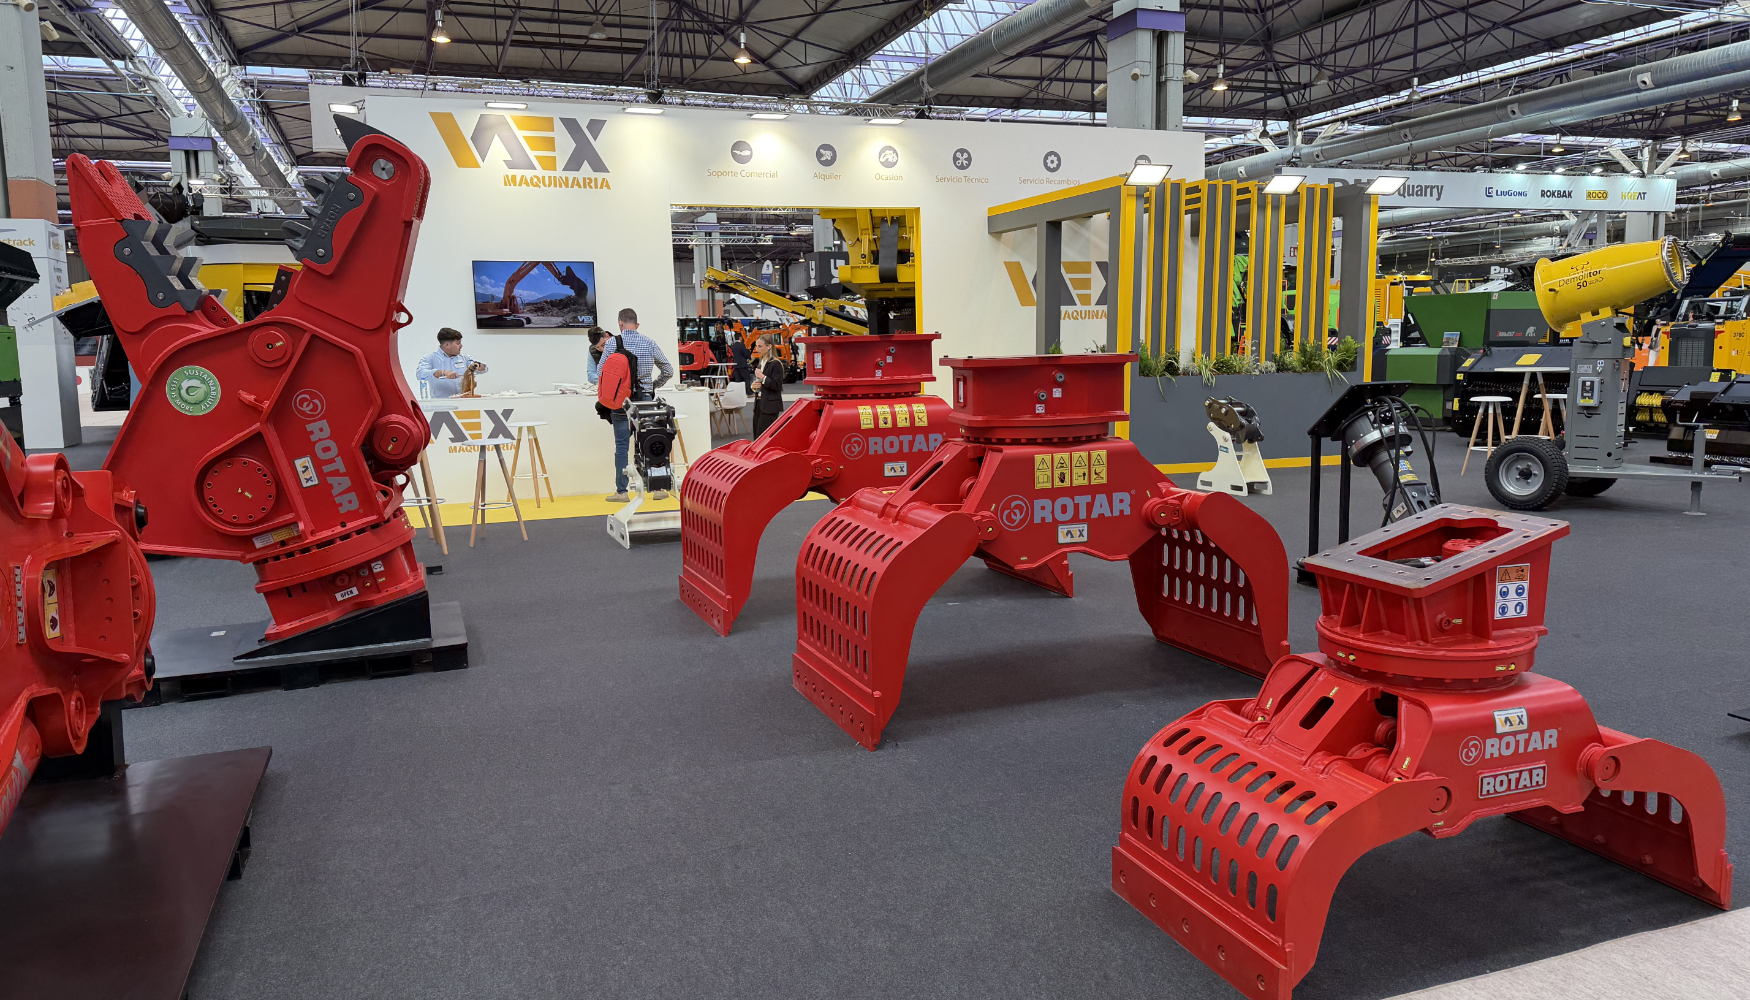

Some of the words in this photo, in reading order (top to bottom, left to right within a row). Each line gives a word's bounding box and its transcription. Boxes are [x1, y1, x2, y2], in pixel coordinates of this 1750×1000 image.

[707, 168, 738, 178] Soporte
[740, 169, 778, 179] Comercial
[813, 171, 842, 181] Alquiler
[874, 172, 904, 181] Ocasión
[503, 174, 611, 190] MAQUINARIA
[935, 175, 962, 184] Servicio
[963, 175, 990, 185] Técnico
[1018, 177, 1045, 186] Servicio
[1045, 177, 1081, 187] Recambios
[1397, 183, 1444, 201] Quarry
[1540, 189, 1573, 199] ROKBAK
[1587, 190, 1608, 199] ROCO
[1576, 280, 1588, 290] 50
[184, 369, 217, 411] SUSTAINABILITY
[174, 399, 194, 412] MORE
[305, 419, 360, 515] ROTAR
[1033, 492, 1131, 524] ROTAR
[1484, 728, 1559, 760] ROTAR
[1481, 768, 1544, 795] ROTAR
